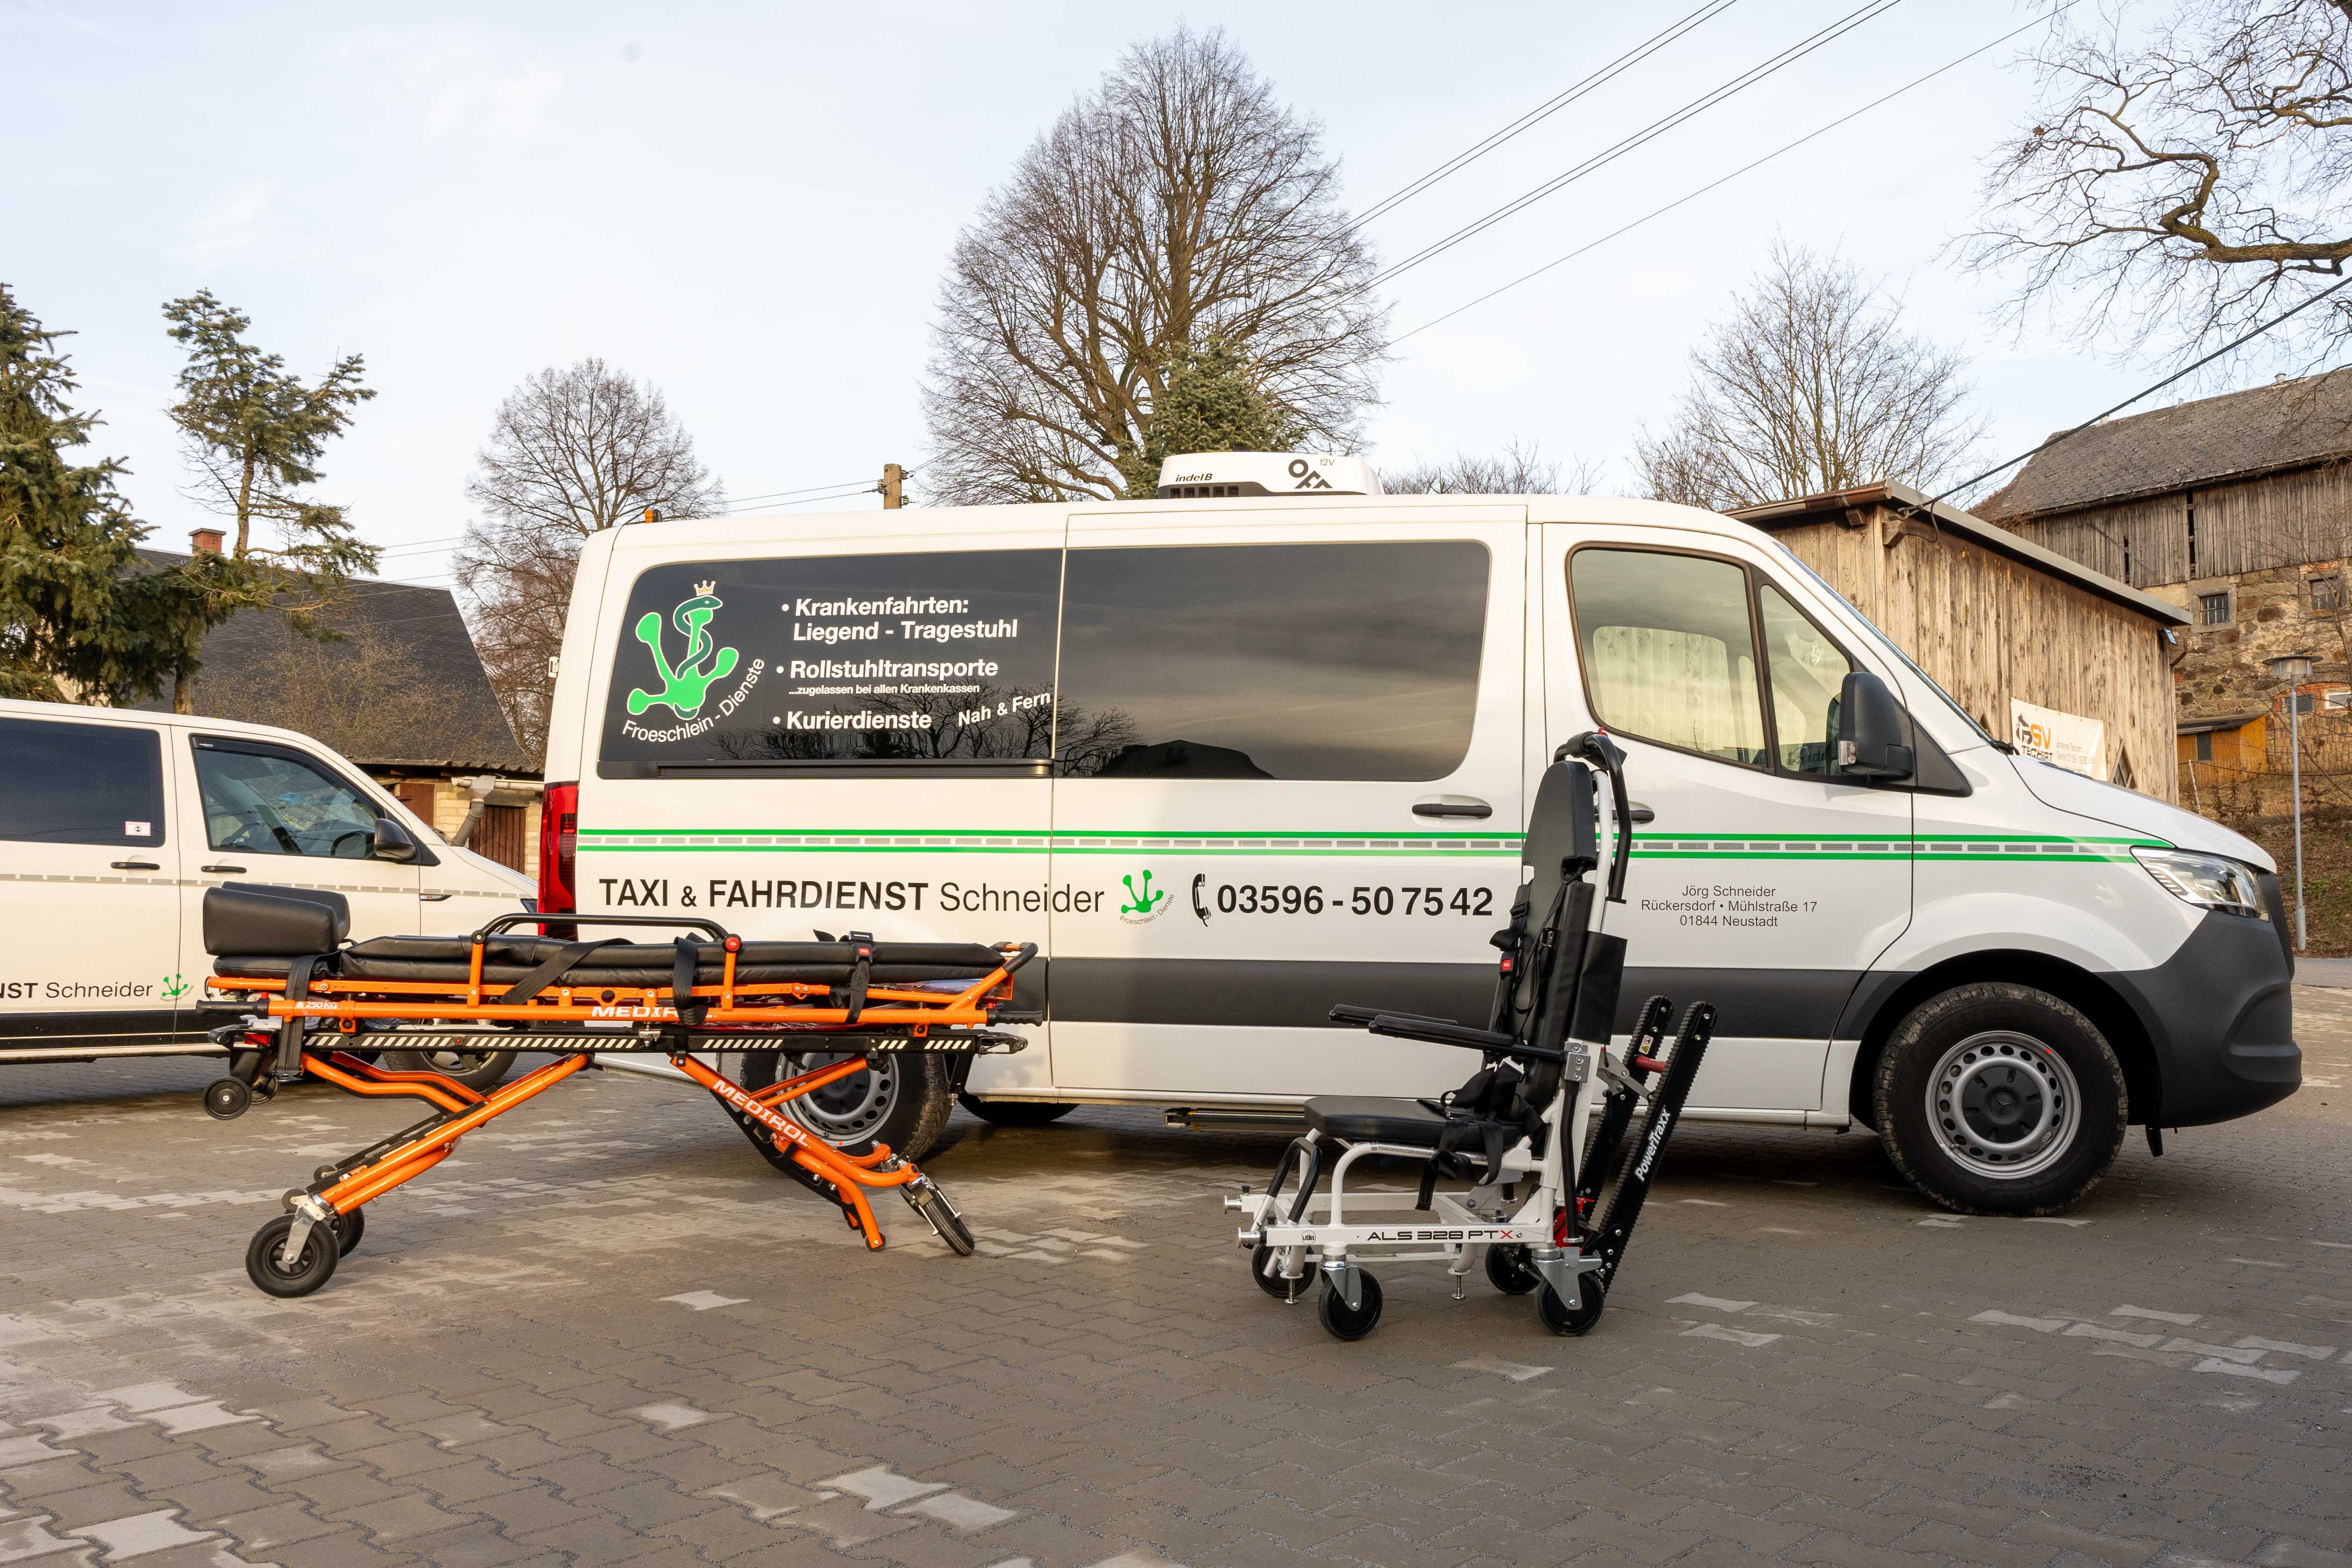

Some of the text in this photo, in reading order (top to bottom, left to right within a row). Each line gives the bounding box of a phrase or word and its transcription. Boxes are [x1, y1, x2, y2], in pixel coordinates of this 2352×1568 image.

[795, 596, 969, 616] Krankenfahrten:
[794, 621, 879, 643] Liegend
[901, 619, 1018, 643] Tragestuhl
[790, 659, 998, 681] Rollstuhltransporte
[855, 684, 872, 694] bei
[873, 684, 898, 694] allen
[900, 683, 980, 694] Krankenkassen
[622, 717, 714, 742] Froeschlein
[718, 658, 765, 716] Dienste
[958, 692, 1051, 727] Nah & Fern
[787, 710, 932, 730] Kurierdienste
[599, 878, 1105, 913] TAXI & FAHRDIENST Schneider
[1217, 884, 1323, 915] 03596
[1682, 885, 1776, 899] Jörg Schneider
[1119, 915, 1156, 925] Froeschlein
[1157, 894, 1174, 916] Dienste
[1641, 900, 1817, 912] Rückersdorf Mühlstraße 17
[1680, 915, 1778, 927] 01844 Neustadt
[45, 981, 153, 998] Schneider
[591, 1006, 714, 1018] MEDIR
[713, 1079, 809, 1147] MEDIROL
[1635, 1107, 1671, 1182] PowerTraxx
[1367, 1231, 1413, 1241] ALS
[1417, 1231, 1463, 1240] 328
